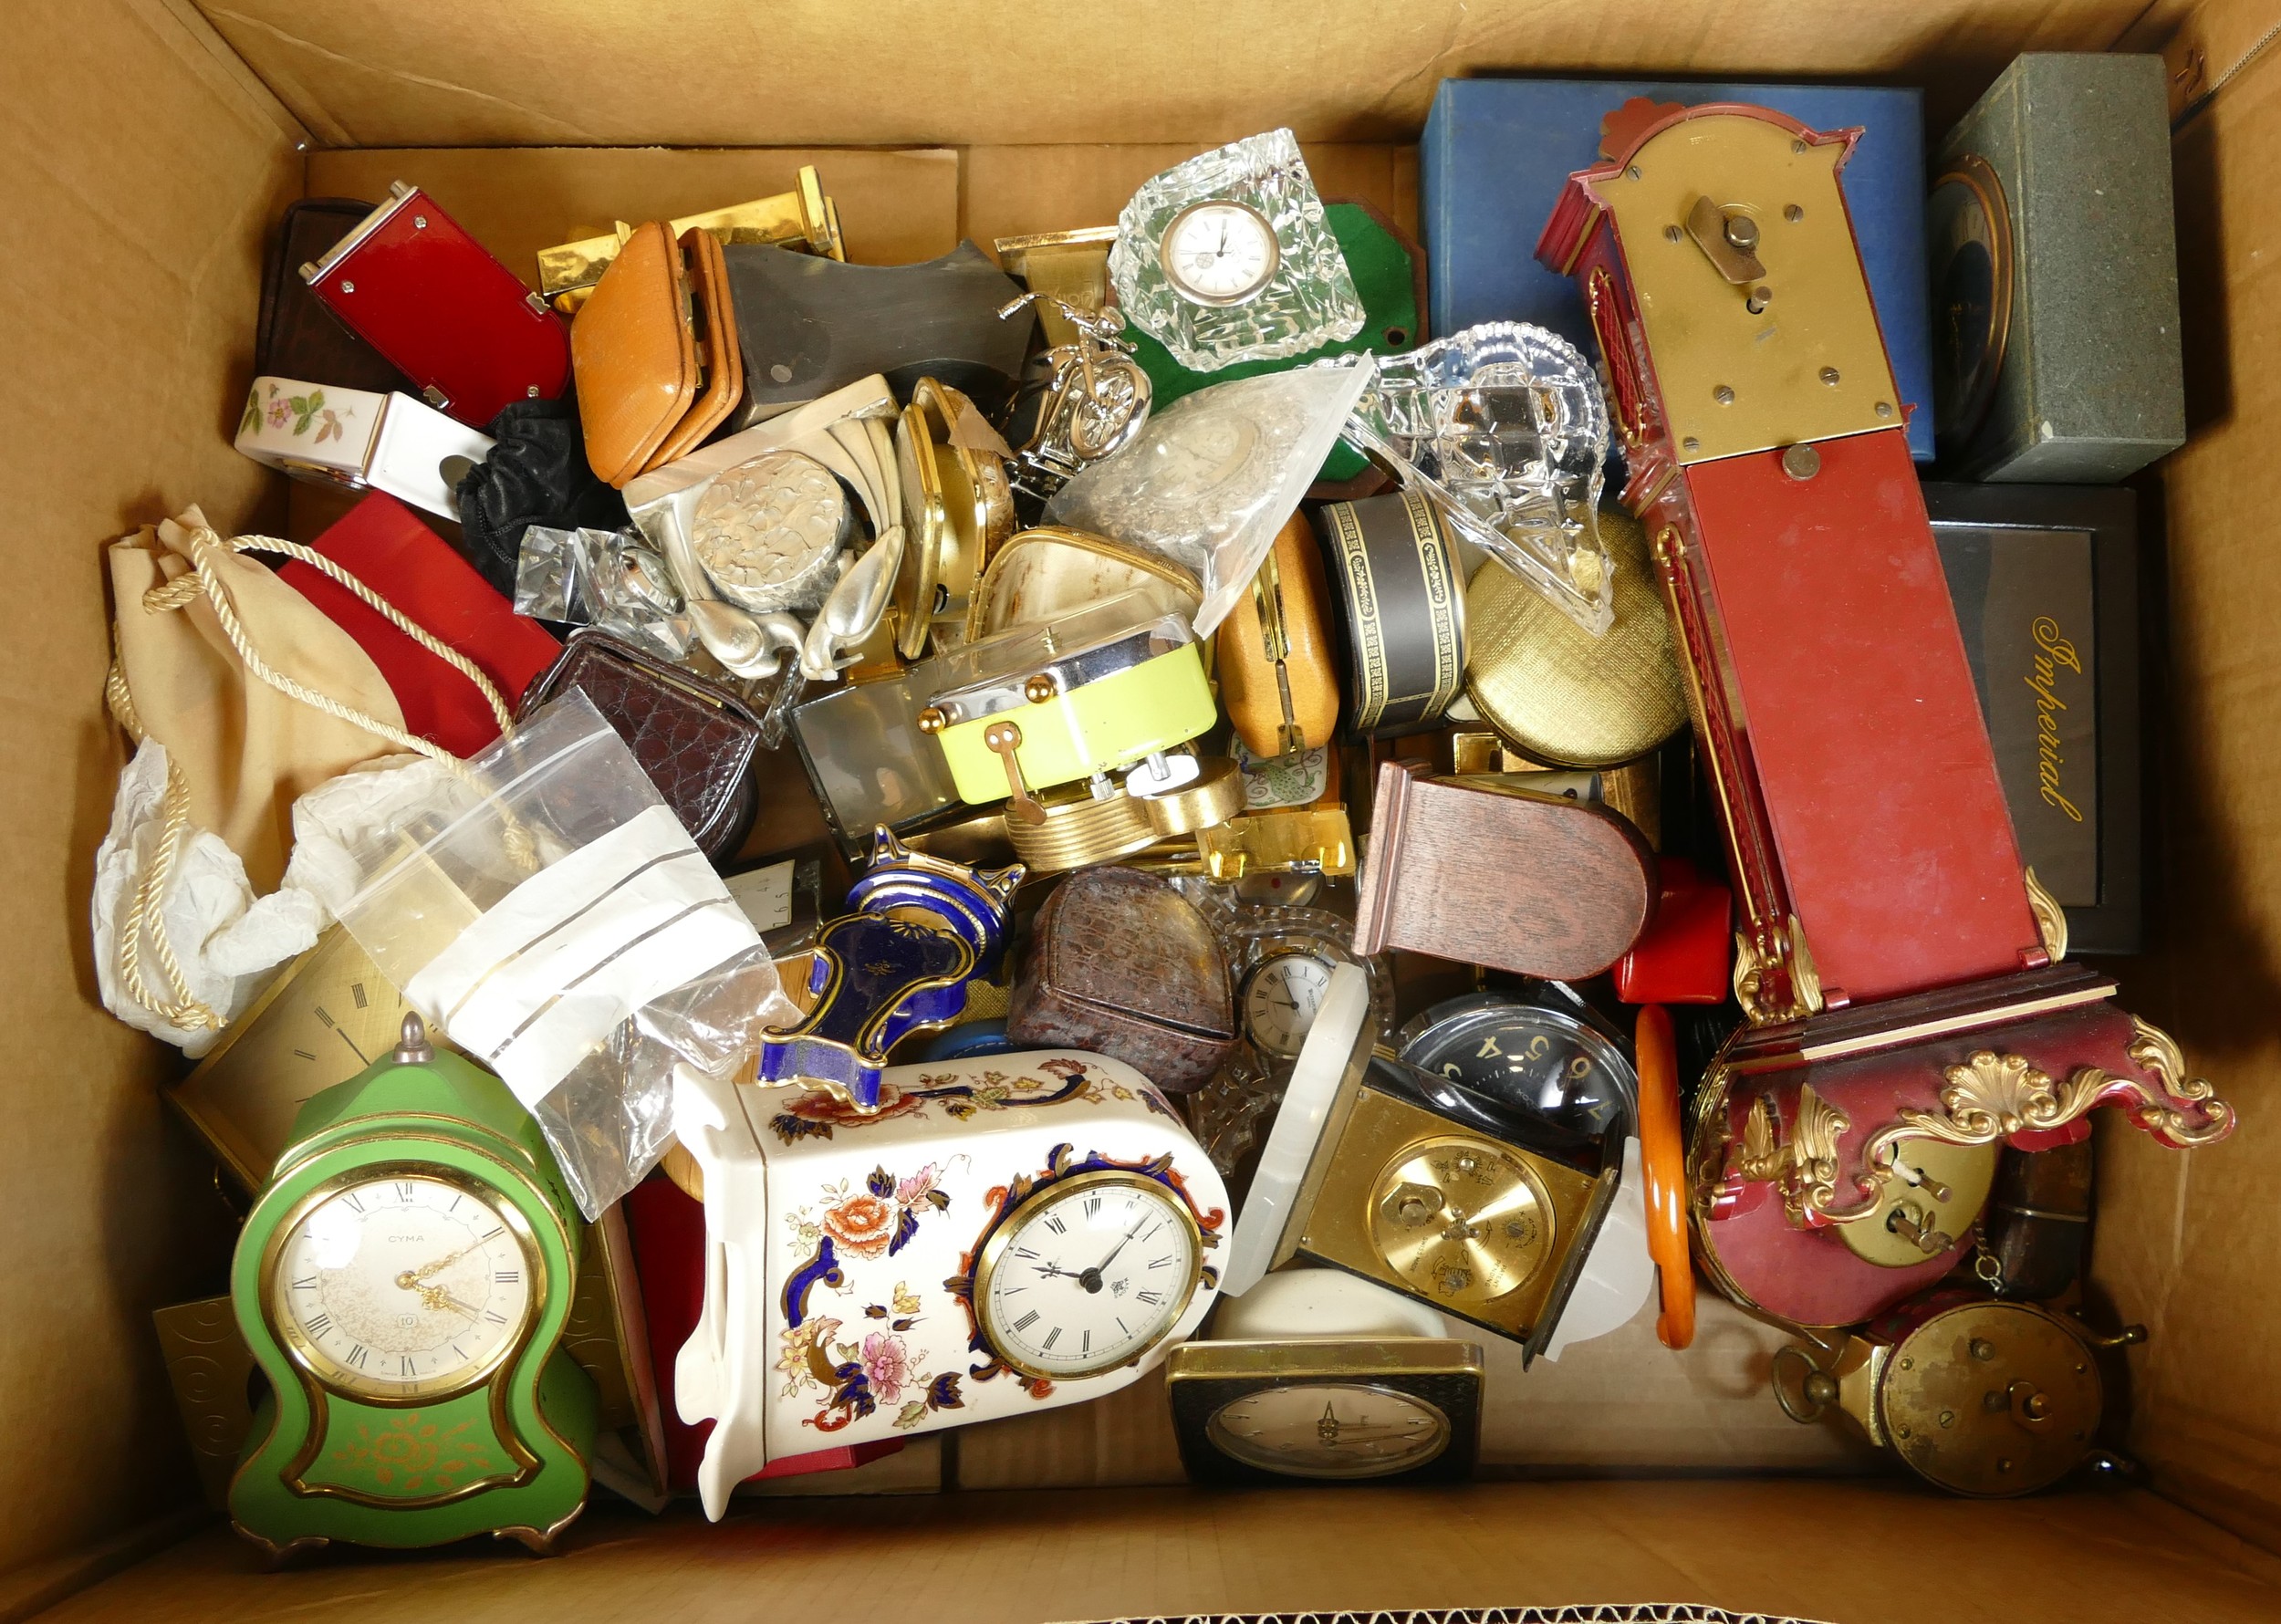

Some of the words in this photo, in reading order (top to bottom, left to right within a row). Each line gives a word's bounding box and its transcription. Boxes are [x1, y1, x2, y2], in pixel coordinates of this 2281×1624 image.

[2023, 615, 2083, 824] Imperial
[314, 1005, 335, 1028] III
[1476, 1036, 1503, 1059] 4
[1525, 1036, 1550, 1062] 5
[1566, 1057, 1591, 1079] 6
[1587, 1100, 1613, 1121] 7
[341, 1192, 366, 1213] XI
[395, 1182, 413, 1202] XII
[449, 1194, 463, 1213] I
[1083, 1197, 1102, 1223] VIII
[1044, 1213, 1067, 1236] VII
[1140, 1223, 1163, 1244] X
[388, 1234, 425, 1244] CYMA
[1416, 1236, 1429, 1255] SWISS
[1015, 1246, 1041, 1261] VI
[1148, 1254, 1173, 1270] XI
[291, 1275, 317, 1290] IX
[495, 1271, 519, 1284] III
[1484, 1259, 1502, 1287] PENDING
[1493, 1264, 1507, 1288] PATENT
[1005, 1286, 1029, 1296] V
[1135, 1286, 1163, 1306] XII
[304, 1313, 334, 1341] VIII
[401, 1316, 414, 1327] 10
[1013, 1308, 1042, 1333] IIII
[1116, 1317, 1130, 1335] I
[1042, 1326, 1063, 1351] III
[1082, 1329, 1091, 1353] II
[345, 1344, 369, 1369] VII
[401, 1356, 418, 1376] VI
